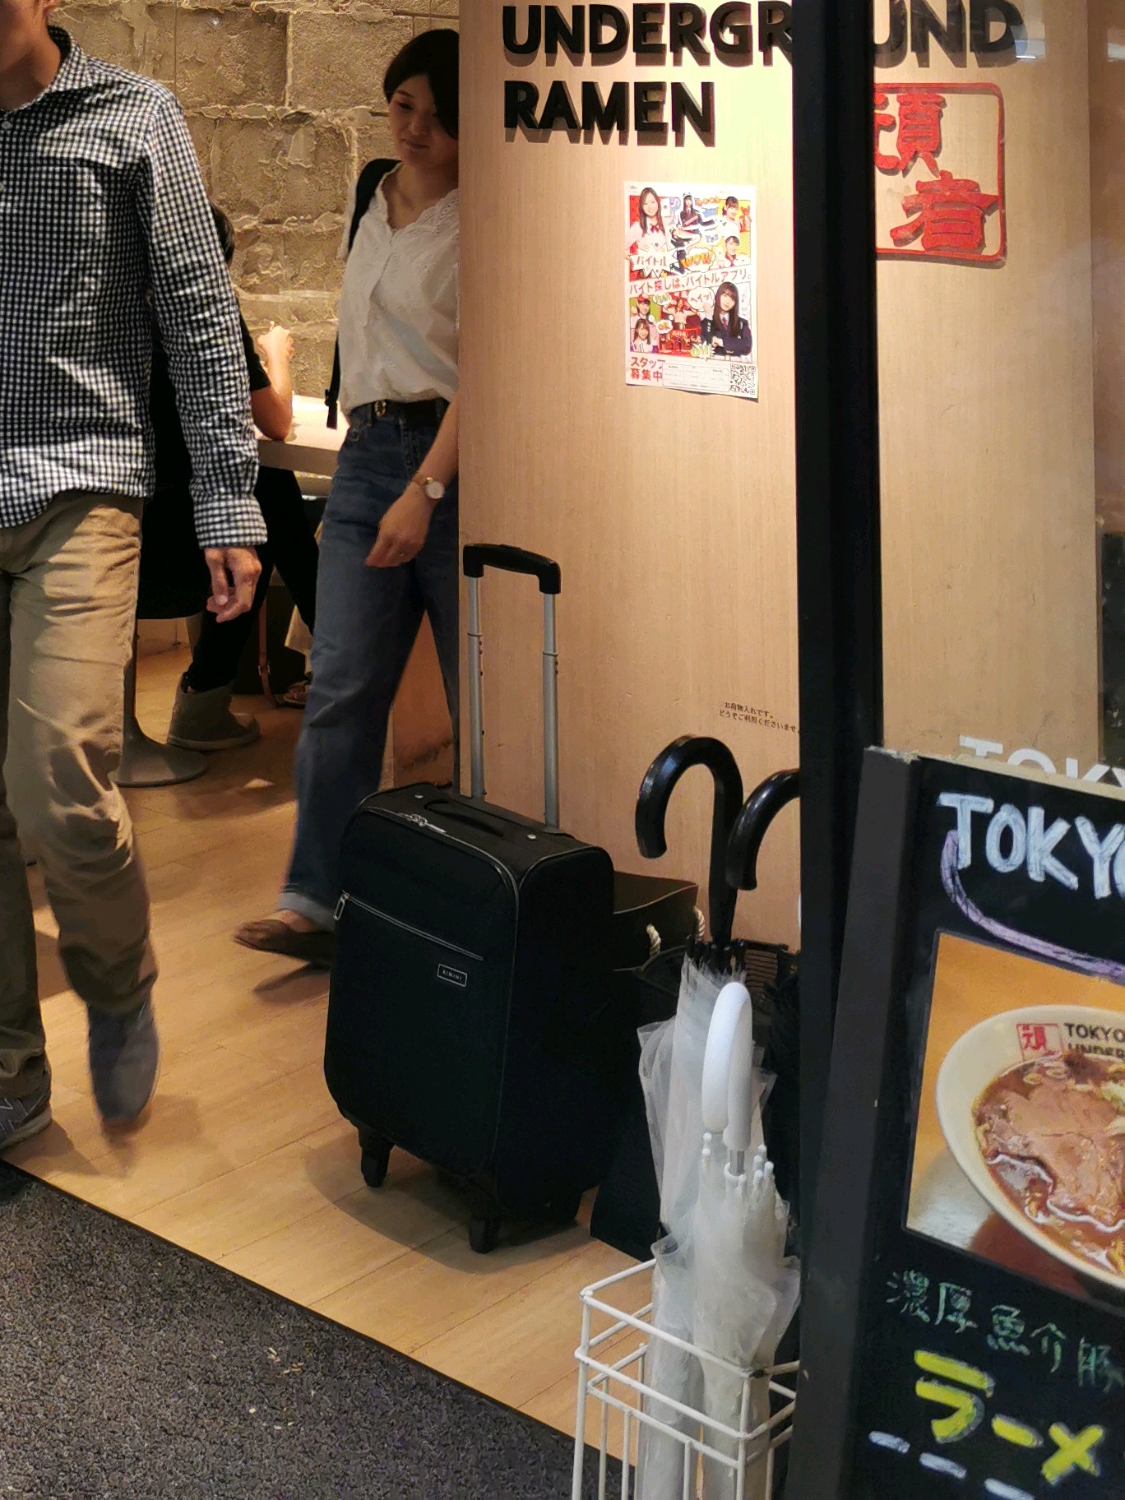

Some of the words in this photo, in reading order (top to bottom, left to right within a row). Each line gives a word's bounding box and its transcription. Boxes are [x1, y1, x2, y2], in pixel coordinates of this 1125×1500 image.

[504, 80, 715, 146] RAMEN
[679, 251, 712, 268] WOW
[630, 368, 663, 382] 募集中
[724, 702, 774, 719] お荷物入れです。
